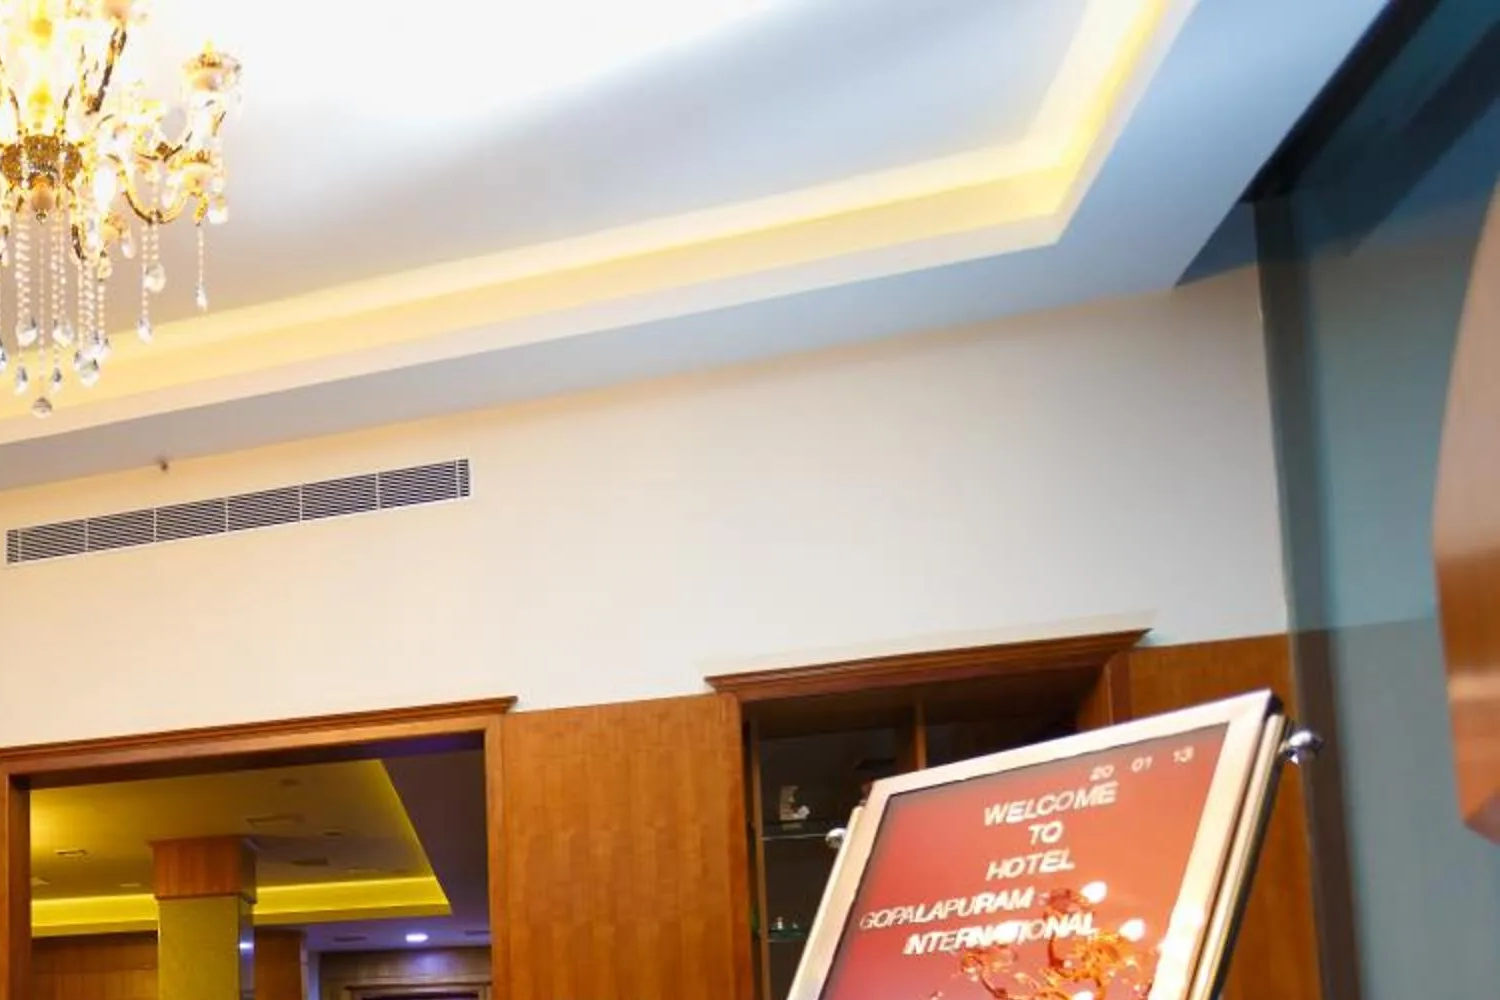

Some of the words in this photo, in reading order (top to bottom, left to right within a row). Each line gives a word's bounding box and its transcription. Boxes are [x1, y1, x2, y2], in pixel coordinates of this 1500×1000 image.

[983, 780, 1119, 826] WELCOME
[1028, 821, 1063, 844] TO
[986, 849, 1075, 881] HOTEL
[860, 886, 1035, 930] GOPALAPURAM
[902, 911, 1100, 955] INTERNATIONAL
